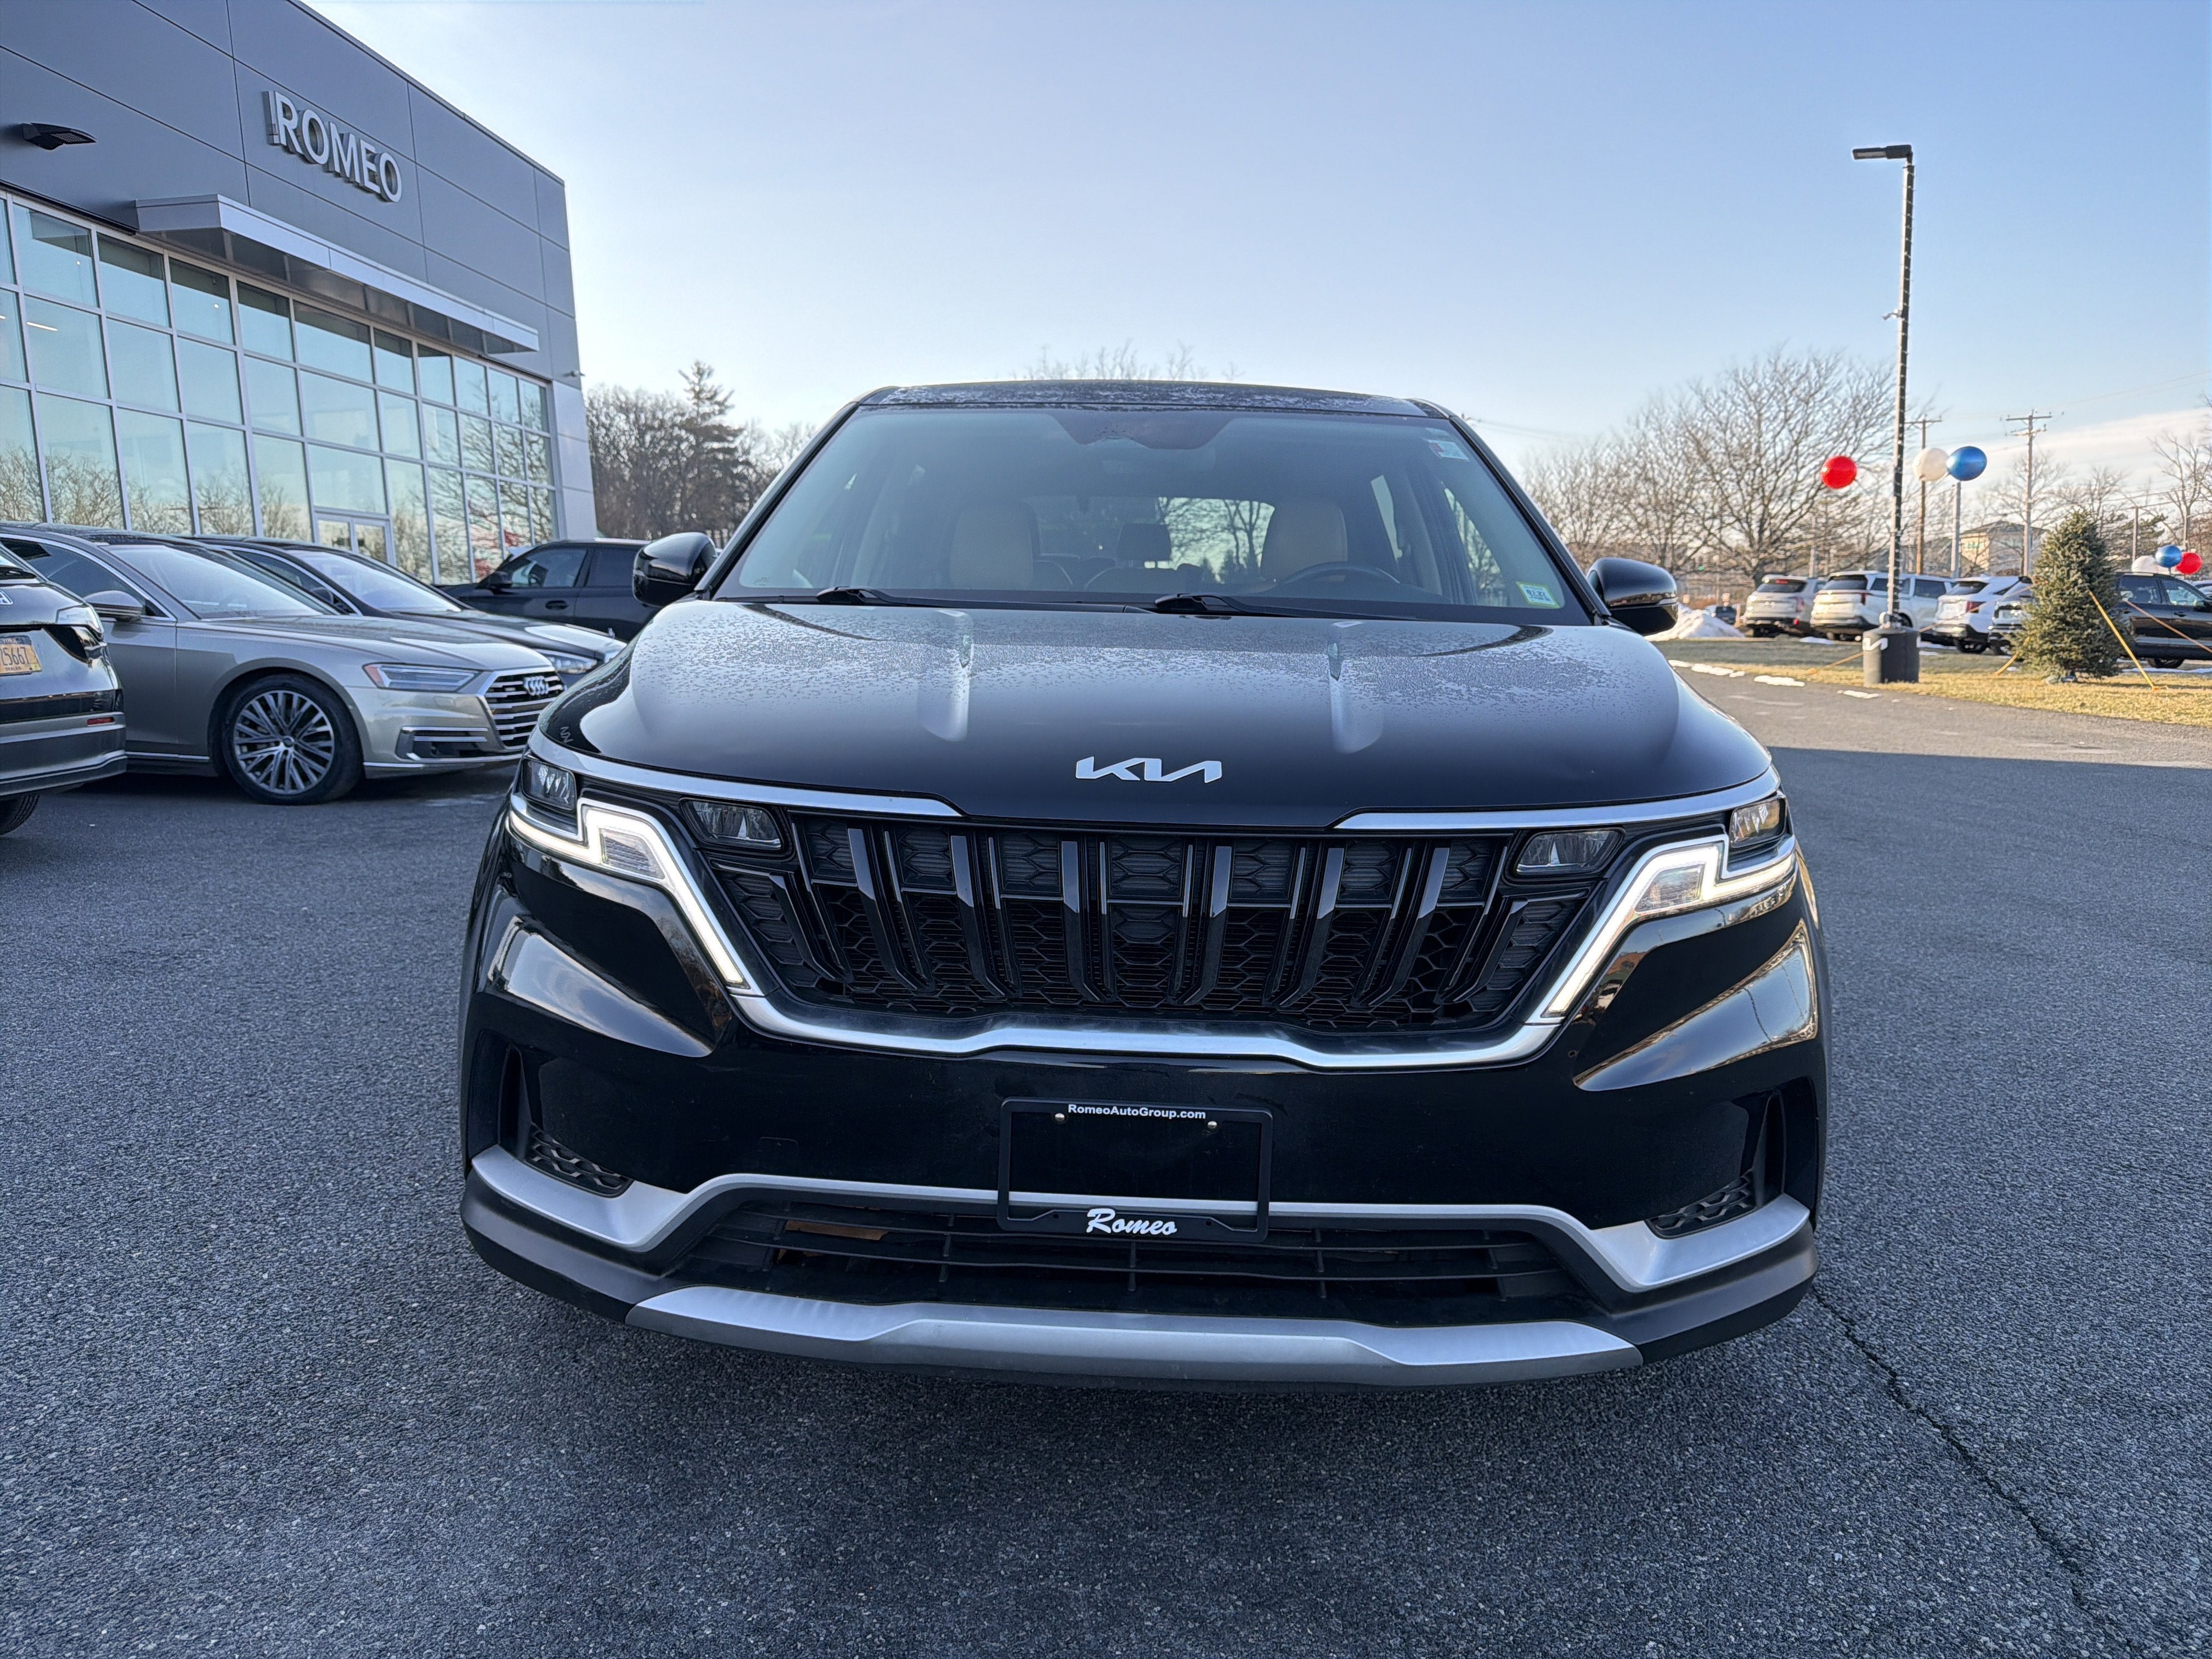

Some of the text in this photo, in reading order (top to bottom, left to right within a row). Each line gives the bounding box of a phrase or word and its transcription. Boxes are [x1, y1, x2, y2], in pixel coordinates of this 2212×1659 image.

[270, 91, 402, 202] ROMEO
[1076, 757, 1222, 783] KIA
[1068, 1104, 1206, 1119] RomeoAutoGroup.com
[1086, 1209, 1177, 1235] Romeo
